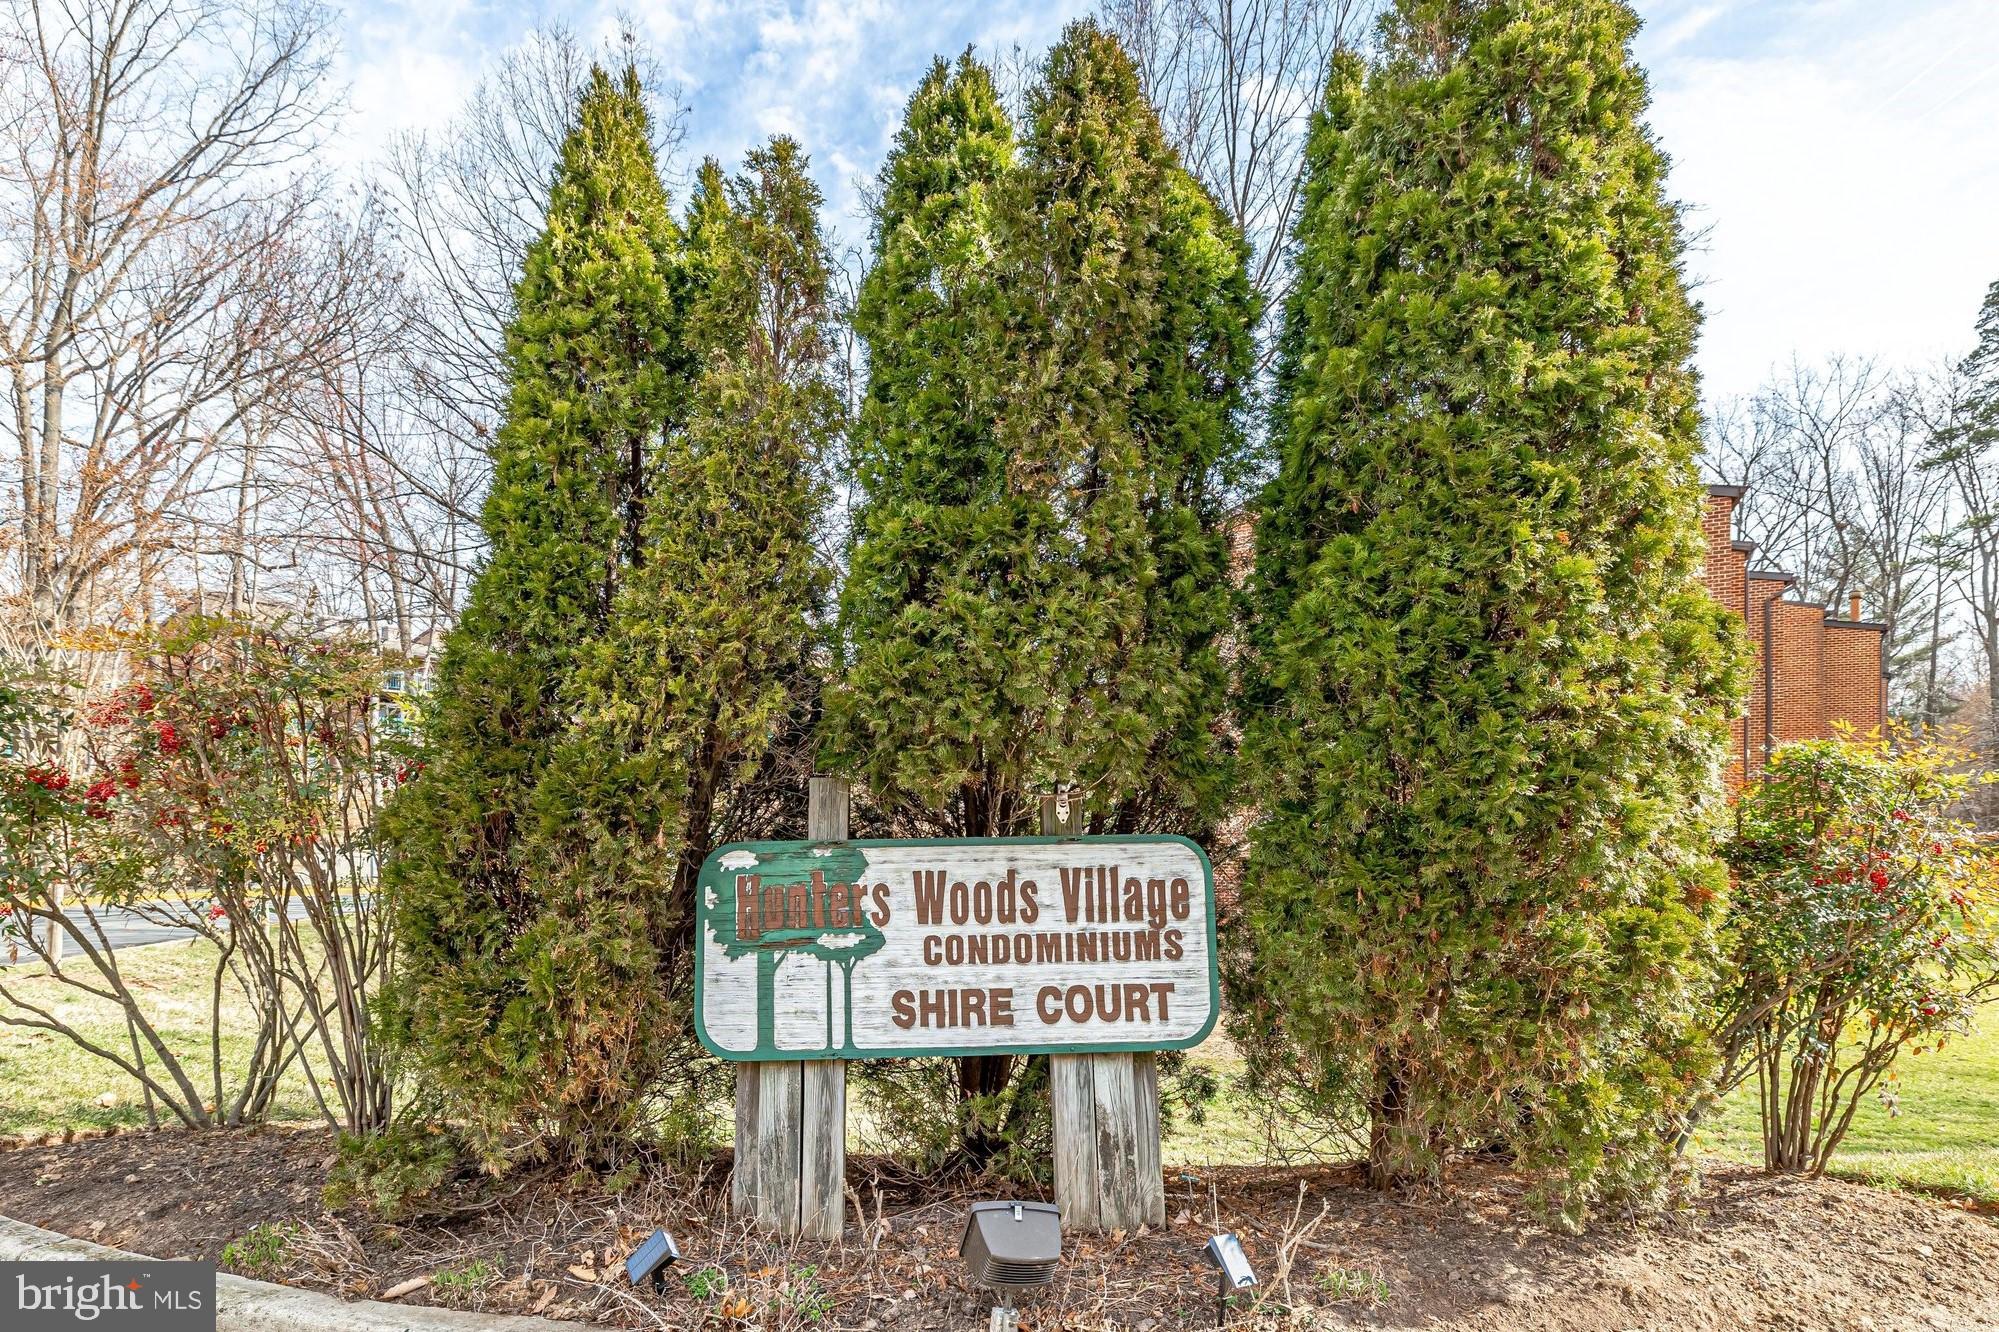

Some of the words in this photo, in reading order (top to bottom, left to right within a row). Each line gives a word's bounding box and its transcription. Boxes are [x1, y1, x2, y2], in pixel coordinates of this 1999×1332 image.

[735, 870, 892, 941] Hunters
[912, 868, 1039, 925] Woods
[1059, 864, 1191, 930] Village
[923, 928, 1184, 966] CONDOMINIUMS
[891, 987, 1015, 1029] SHIRE
[1036, 983, 1176, 1025] COURT
